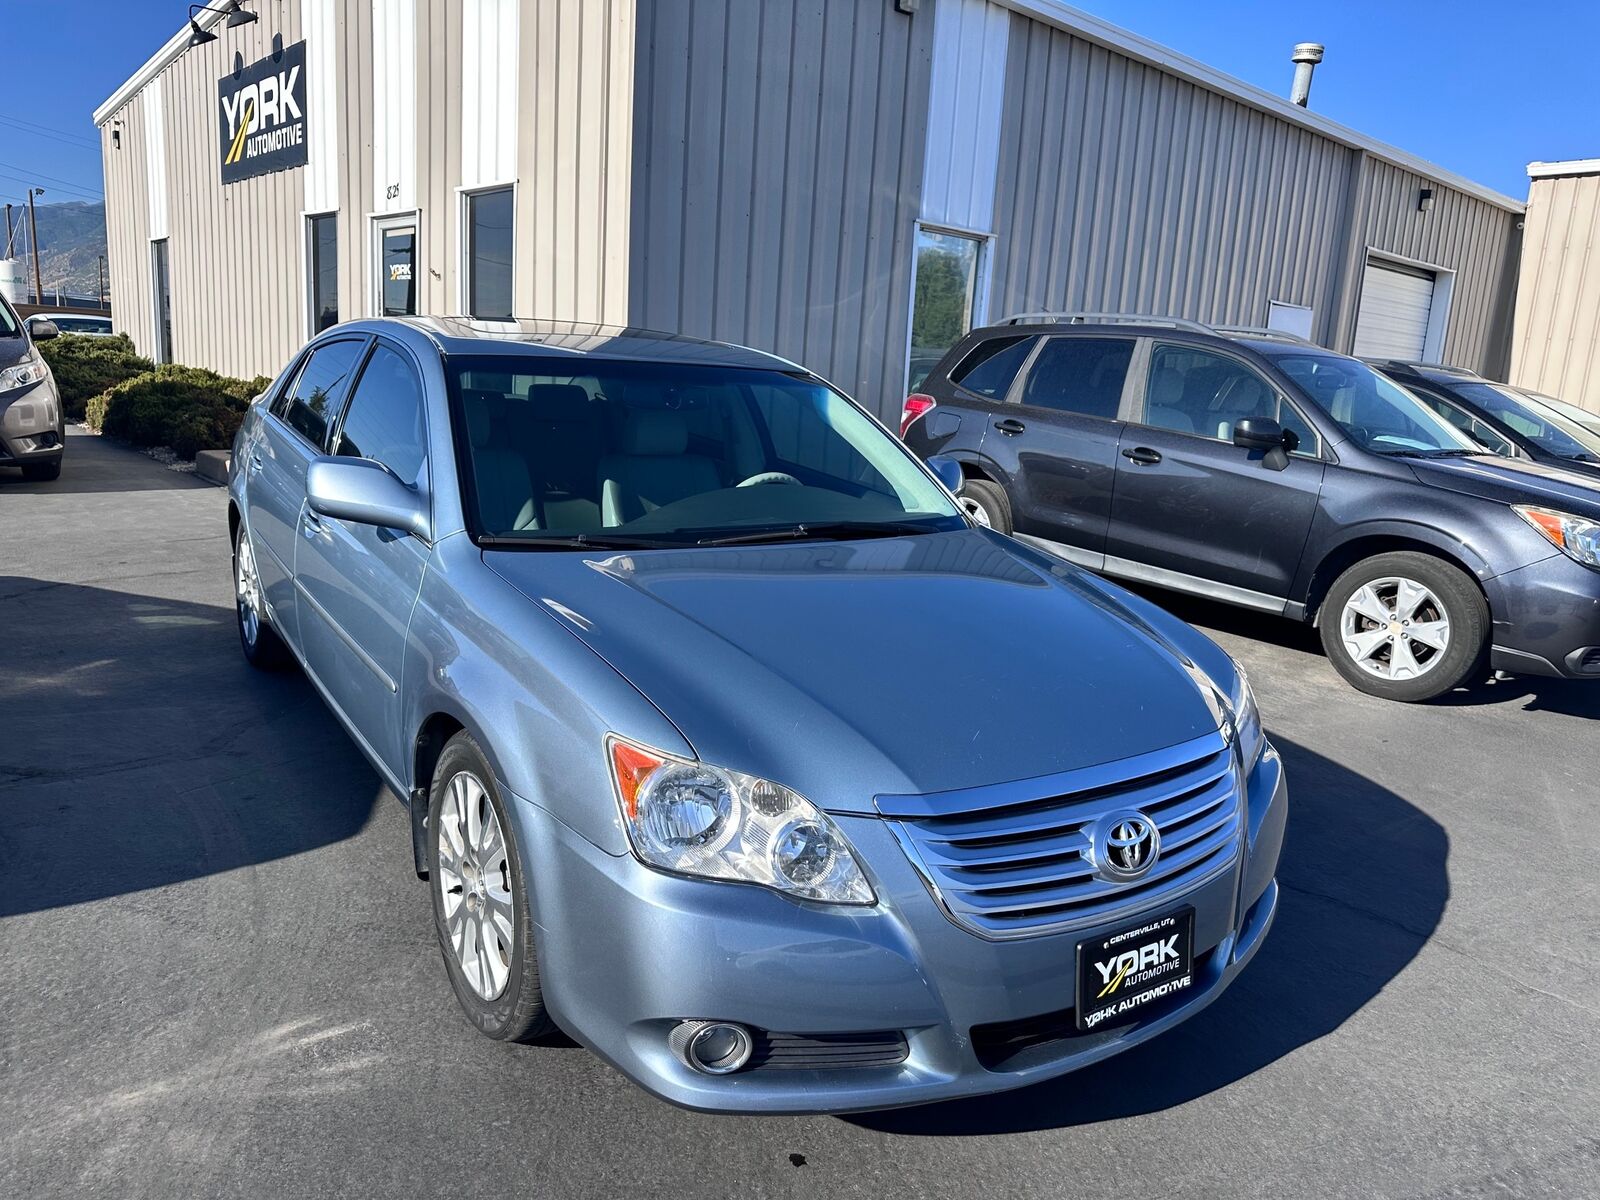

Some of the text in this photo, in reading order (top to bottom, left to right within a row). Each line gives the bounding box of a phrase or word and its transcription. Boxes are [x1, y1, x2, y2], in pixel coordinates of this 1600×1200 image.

[221, 64, 303, 141] YORK
[246, 122, 303, 159] AUTOMOTIVE
[386, 182, 400, 200] 825
[389, 263, 412, 275] YORK
[1109, 917, 1171, 945] CENTERVILLE, UT
[1094, 933, 1180, 985] YORK
[1124, 958, 1180, 988] AUTOMOTIVE
[1118, 975, 1191, 1012] AUTOMOTIVE
